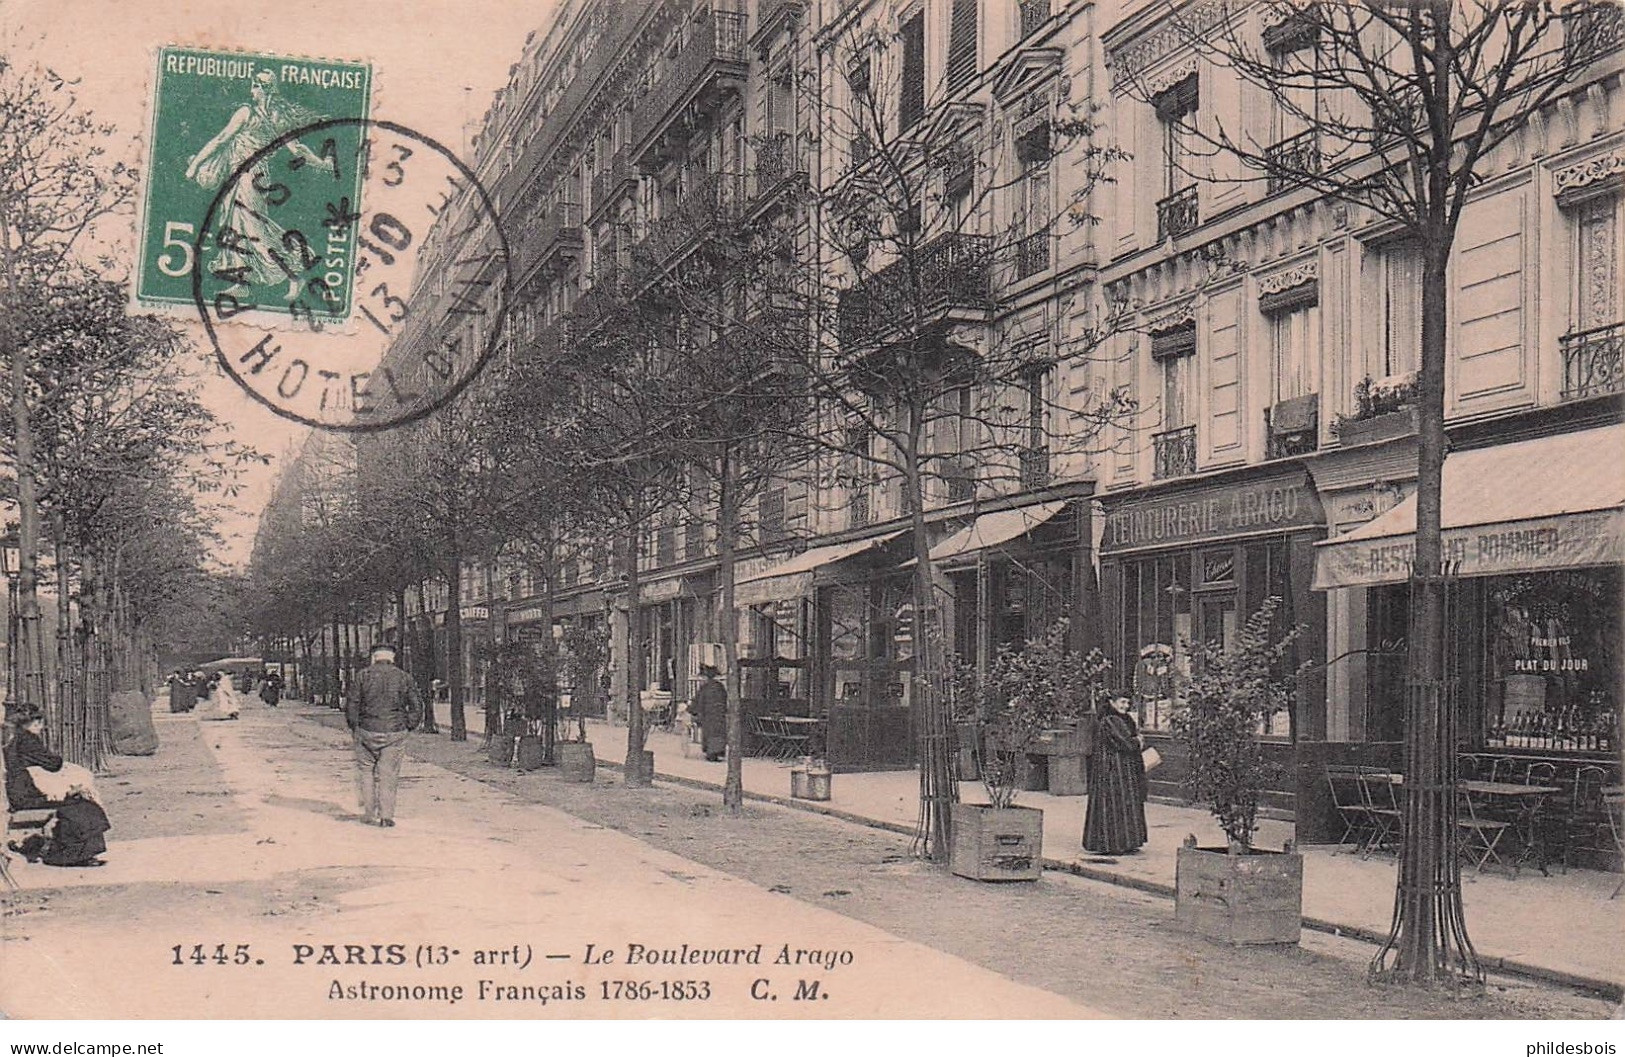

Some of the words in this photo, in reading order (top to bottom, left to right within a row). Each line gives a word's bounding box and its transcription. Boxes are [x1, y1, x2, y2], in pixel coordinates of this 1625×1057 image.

[166, 54, 255, 81] REPUBLIQUE
[280, 64, 362, 90] FRANÇAISE
[1108, 498, 1219, 546] TEINTURERIE
[1227, 484, 1299, 529] ARAGO
[1514, 659, 1538, 671] PLAT
[1543, 659, 1557, 671] DU
[1560, 658, 1588, 671] JOUR
